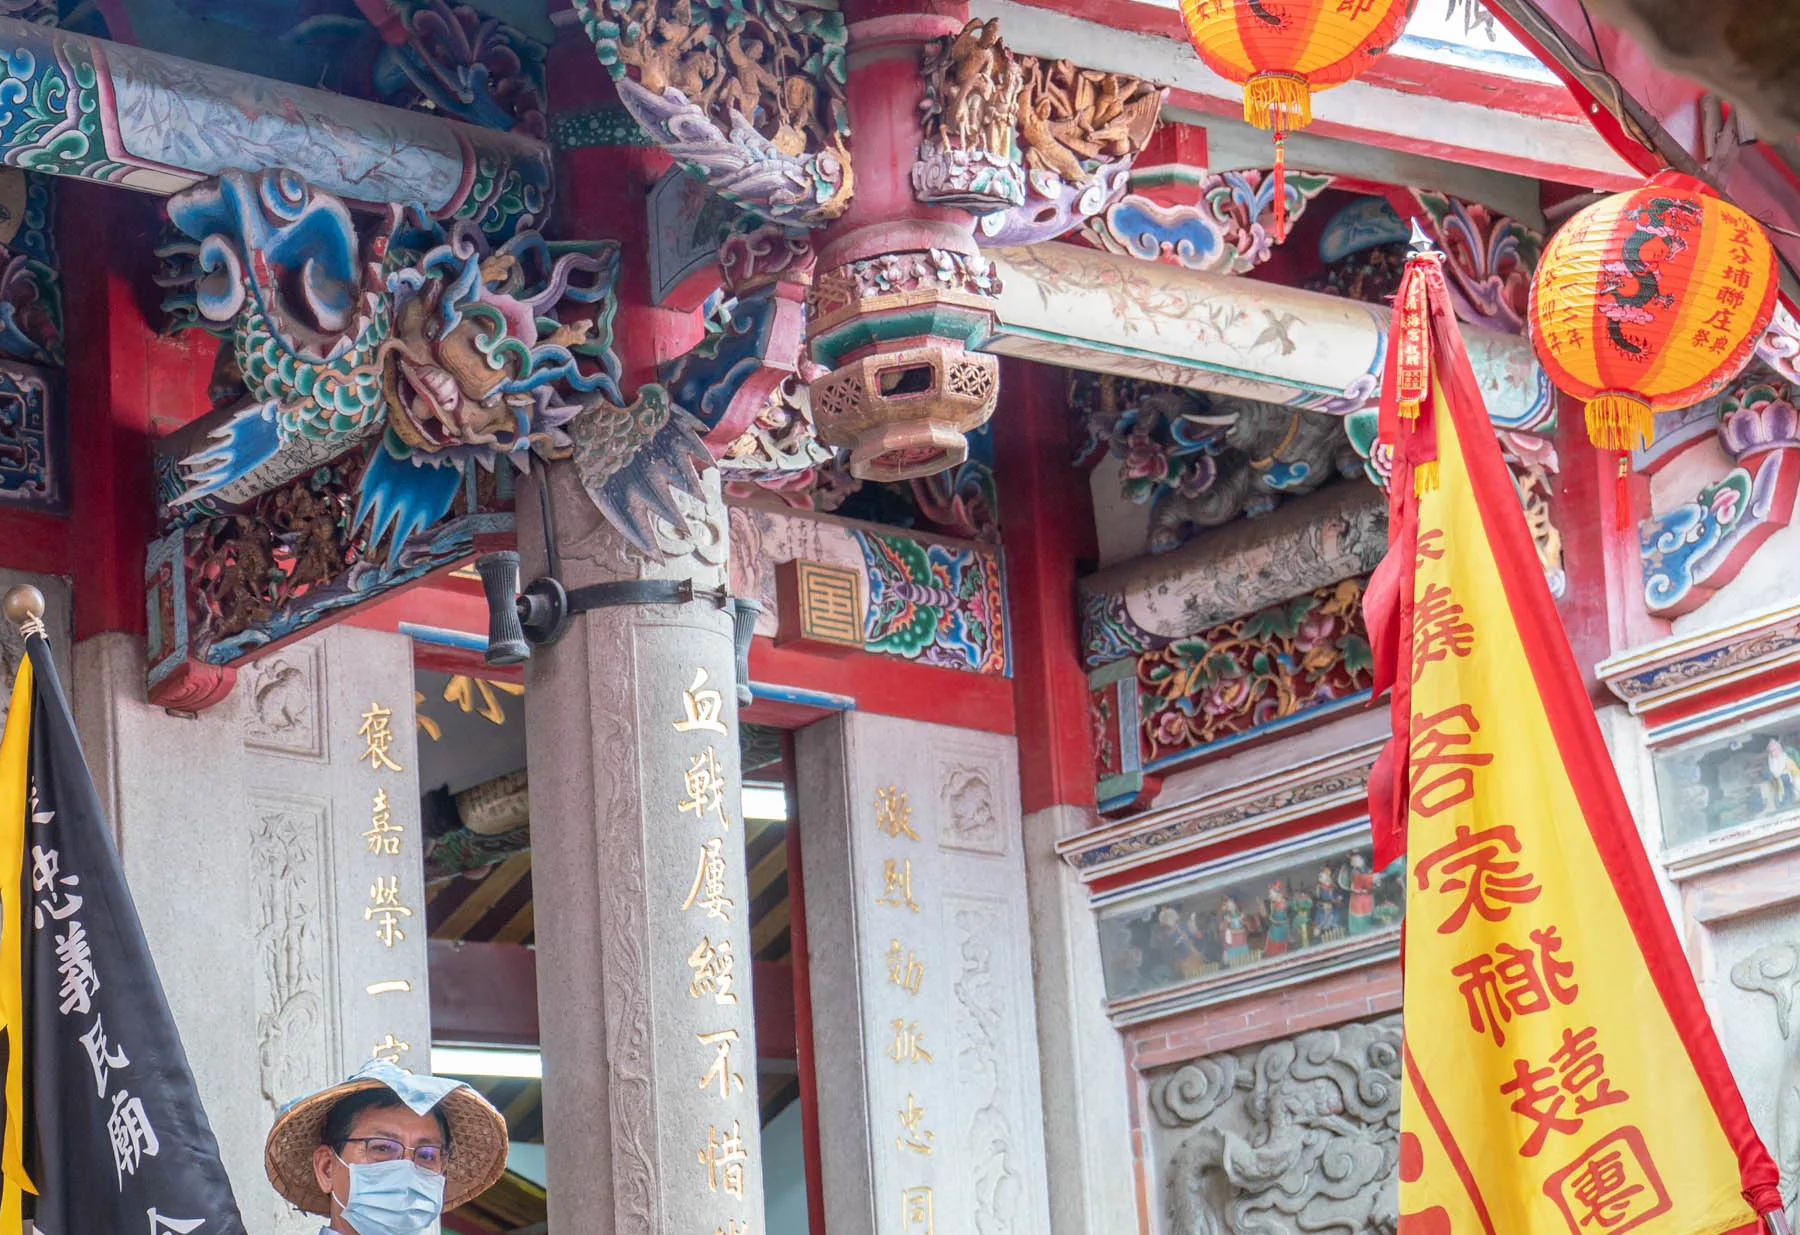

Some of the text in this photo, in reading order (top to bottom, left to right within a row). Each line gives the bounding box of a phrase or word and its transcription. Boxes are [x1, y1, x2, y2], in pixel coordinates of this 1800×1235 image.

[1704, 228, 1754, 333] 五分埔聯庄
